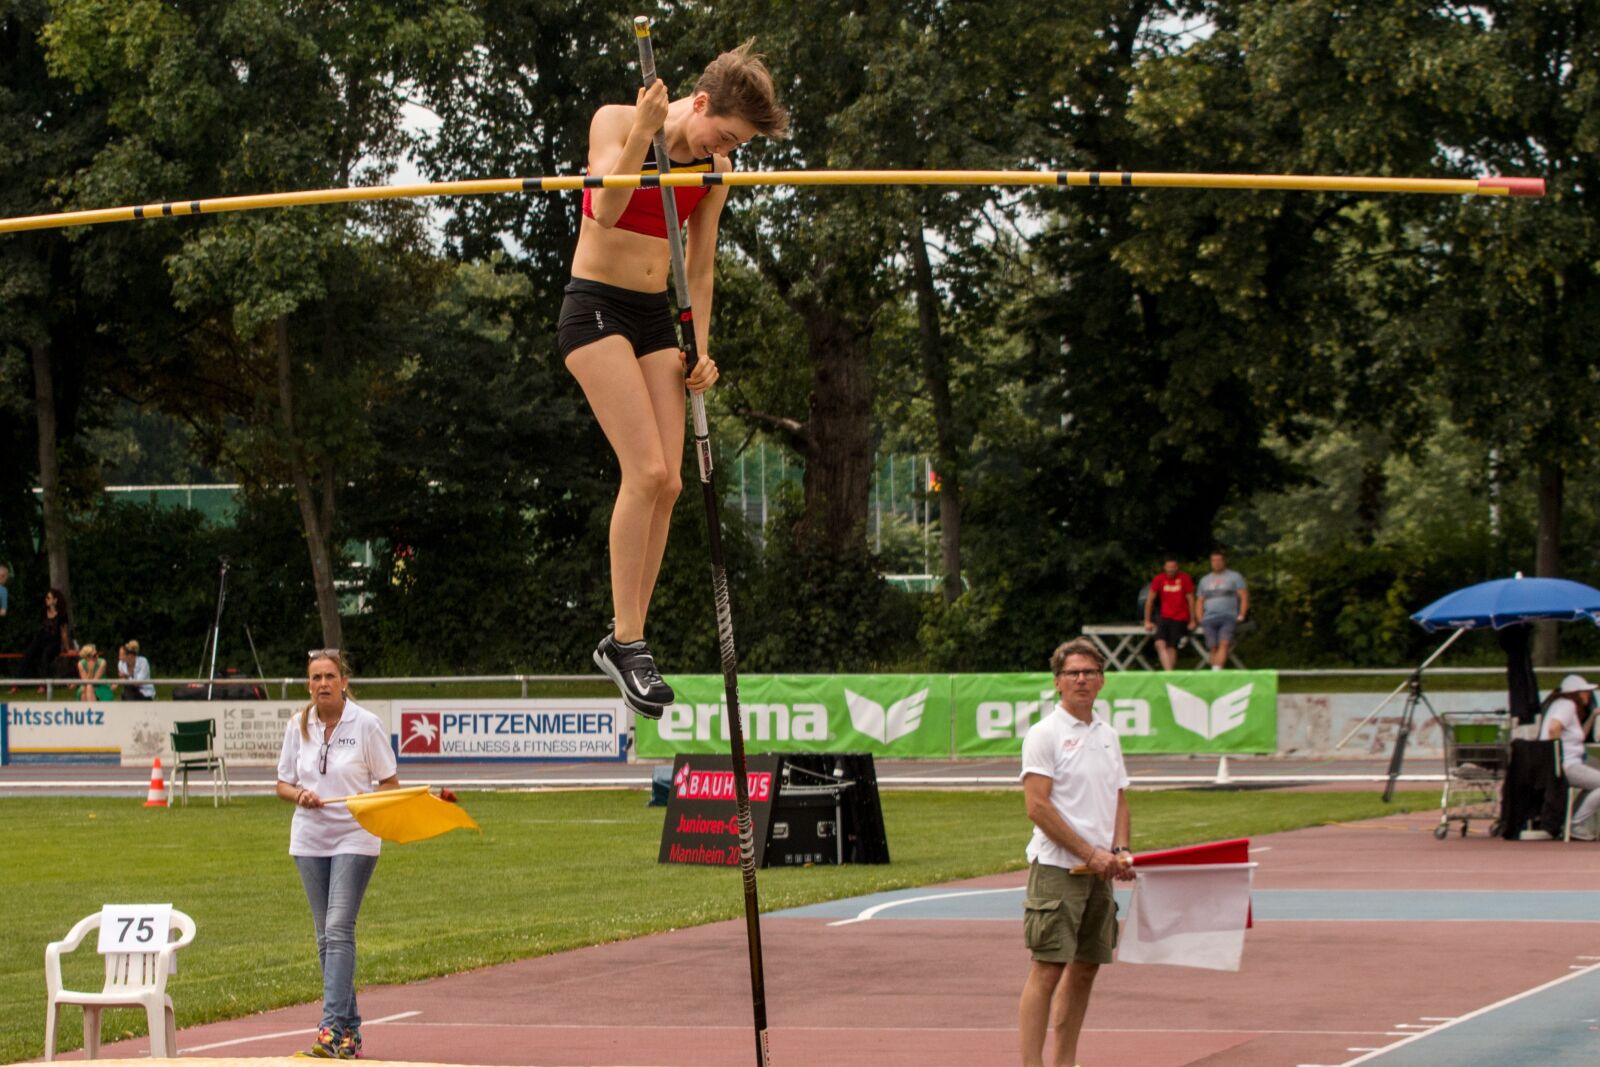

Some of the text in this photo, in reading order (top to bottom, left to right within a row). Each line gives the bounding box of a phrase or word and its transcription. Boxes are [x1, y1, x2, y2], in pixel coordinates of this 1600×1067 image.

[443, 713, 613, 734] PFITZENMEIER
[657, 694, 829, 741] erima
[338, 738, 356, 746] MTG
[443, 740, 613, 752] WELLNESS & FITNESS PARK
[689, 775, 769, 797] BAUHUS
[669, 843, 725, 864] Mannheim
[117, 917, 155, 943] 75
